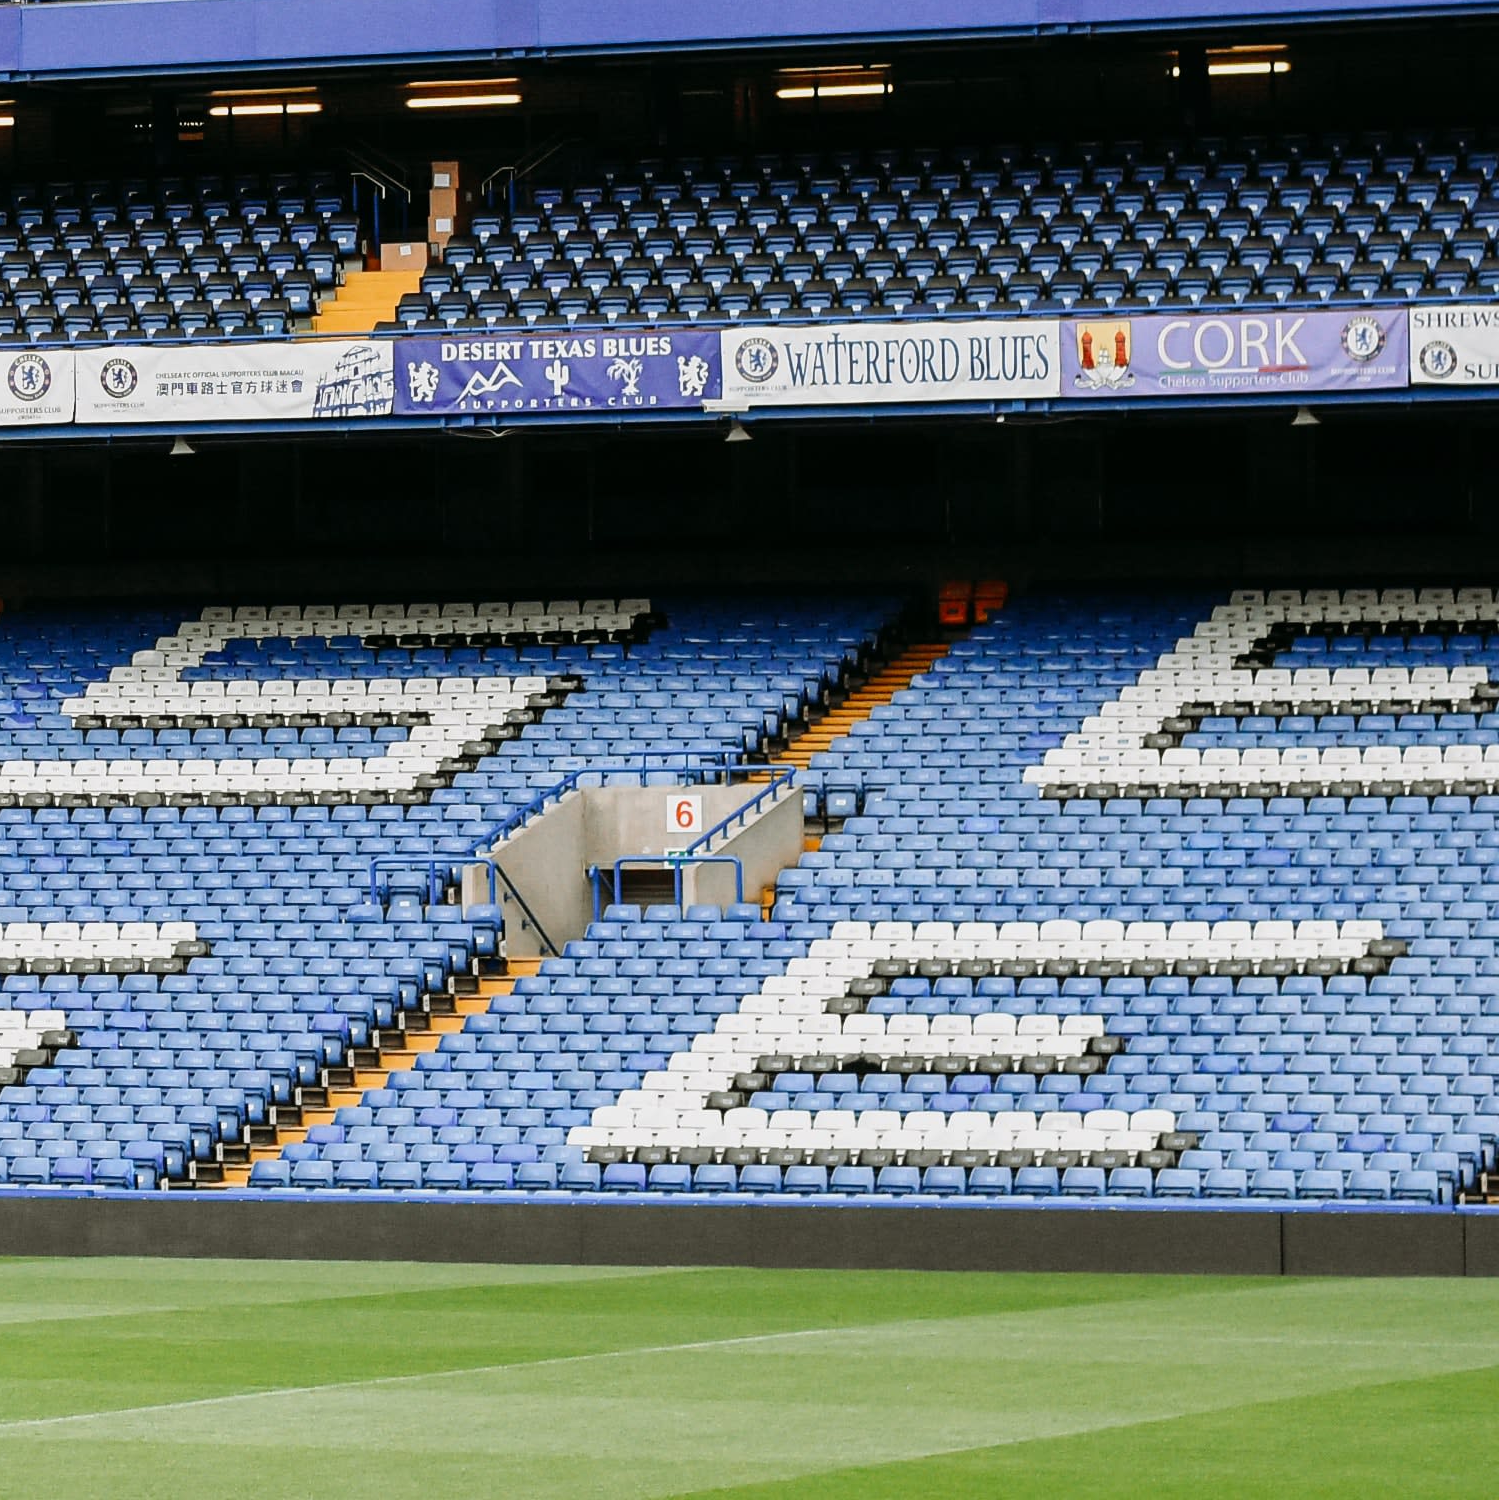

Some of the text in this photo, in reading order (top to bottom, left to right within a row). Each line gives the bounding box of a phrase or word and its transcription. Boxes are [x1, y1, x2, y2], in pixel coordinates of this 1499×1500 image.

[441, 336, 672, 362] DESERT TEXAS BLUES
[1157, 318, 1308, 370] CORK
[784, 333, 1050, 388] WATERFORD BLUES
[221, 370, 261, 378] SUPPORTERS
[1158, 371, 1309, 390] Chelsea Supporters Club
[156, 379, 303, 397] 澳門車路士官方球迷會
[43, 405, 62, 414] CLUB
[459, 395, 657, 410] SUPPORTERS CLUB
[675, 800, 694, 829] 6
